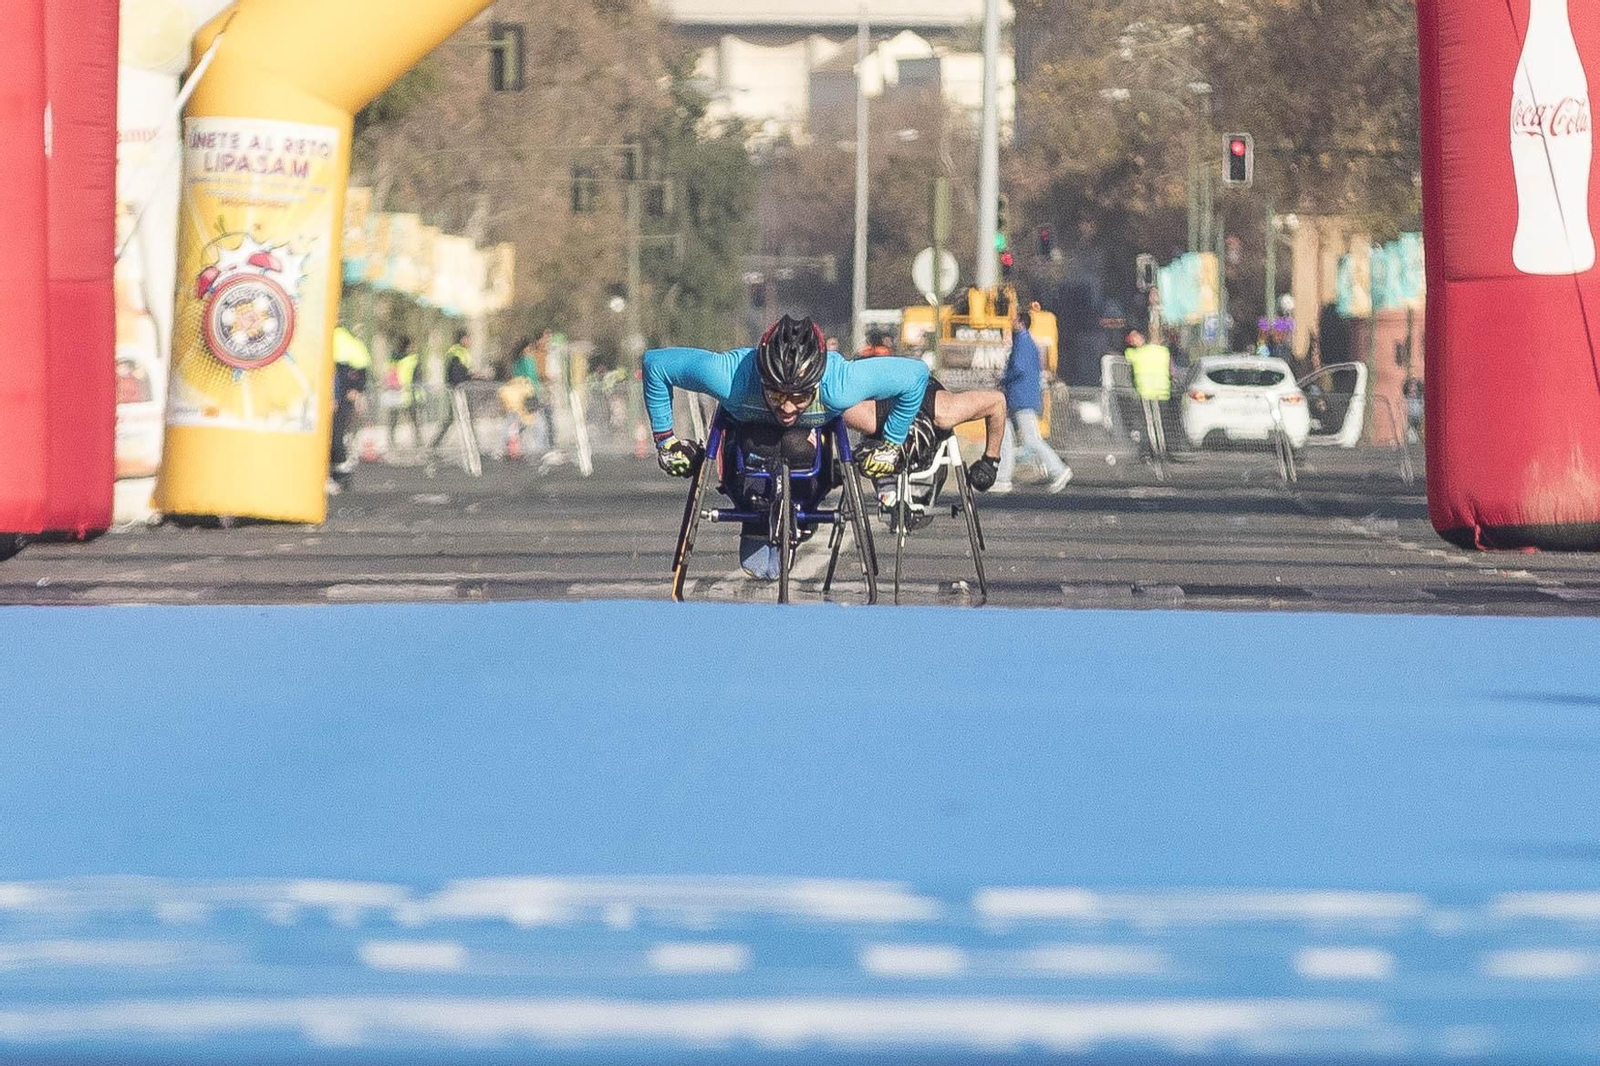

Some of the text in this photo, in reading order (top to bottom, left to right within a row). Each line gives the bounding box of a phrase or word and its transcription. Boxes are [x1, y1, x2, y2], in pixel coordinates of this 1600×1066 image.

[248, 135, 274, 152] AL
[284, 138, 330, 158] RETO
[203, 151, 309, 179] LIPASAM
